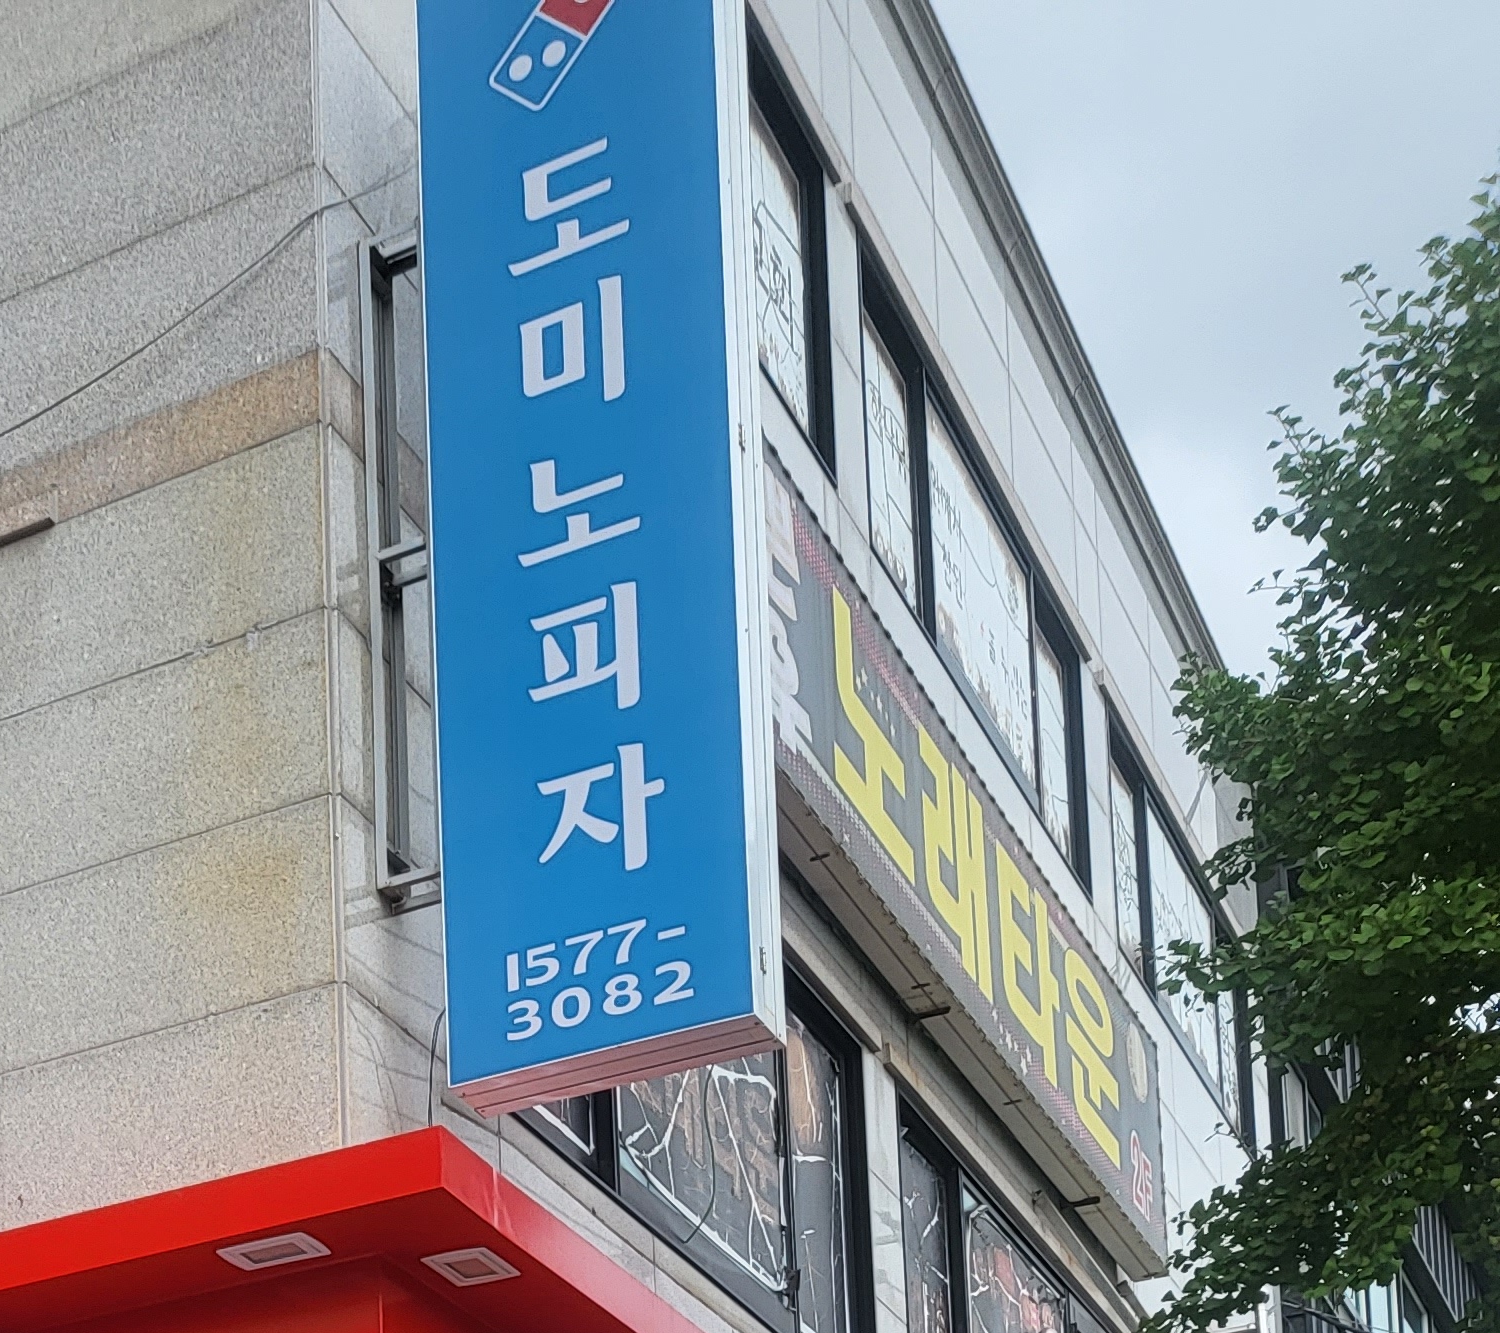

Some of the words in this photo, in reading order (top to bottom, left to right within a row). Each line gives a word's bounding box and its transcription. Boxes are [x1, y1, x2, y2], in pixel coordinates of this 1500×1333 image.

[507, 136, 666, 872] 도미노피자
[505, 917, 688, 993] 1577-
[505, 959, 696, 1042] 3082
[832, 584, 1122, 1172] 노래타운
